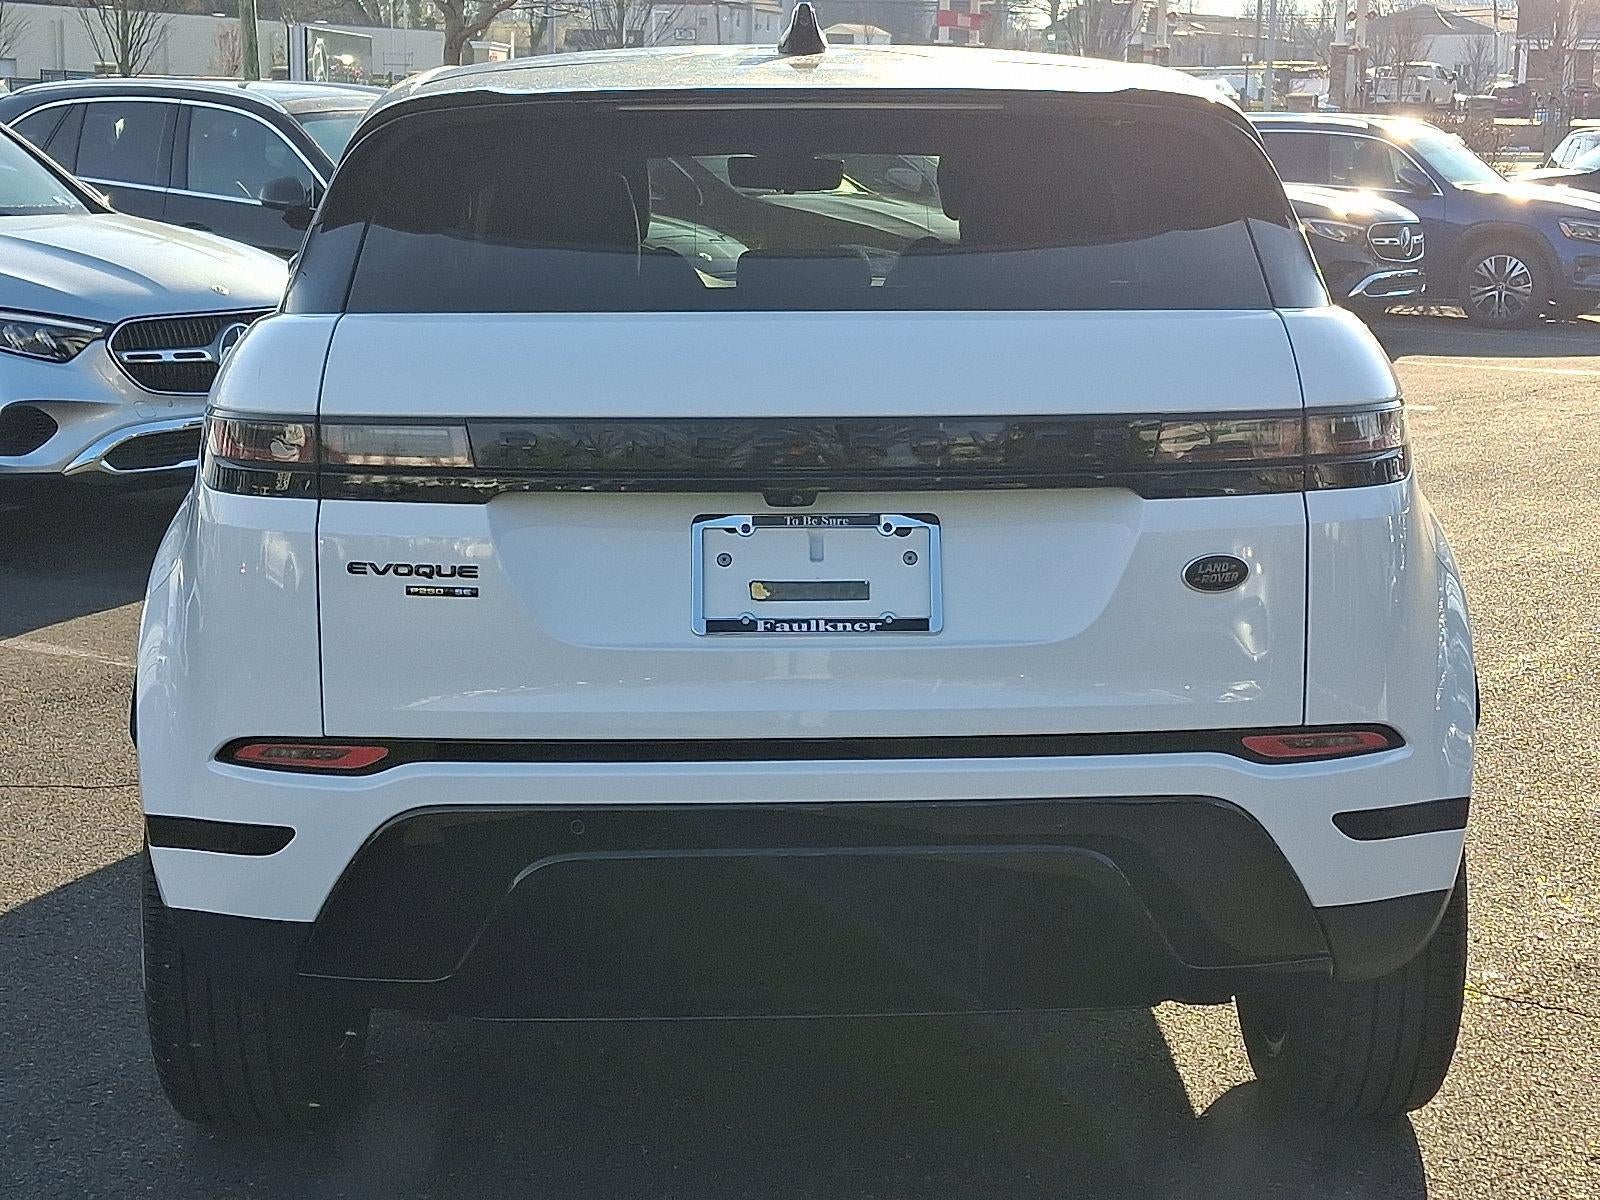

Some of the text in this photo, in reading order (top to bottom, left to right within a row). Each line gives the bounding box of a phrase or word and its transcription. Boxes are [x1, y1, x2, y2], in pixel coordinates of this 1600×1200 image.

[784, 516, 849, 526] To Be Sure
[346, 561, 479, 579] EVOQUE
[1197, 562, 1229, 574] LAND
[1201, 572, 1239, 583] ROVER
[756, 619, 883, 632] Faulkner
